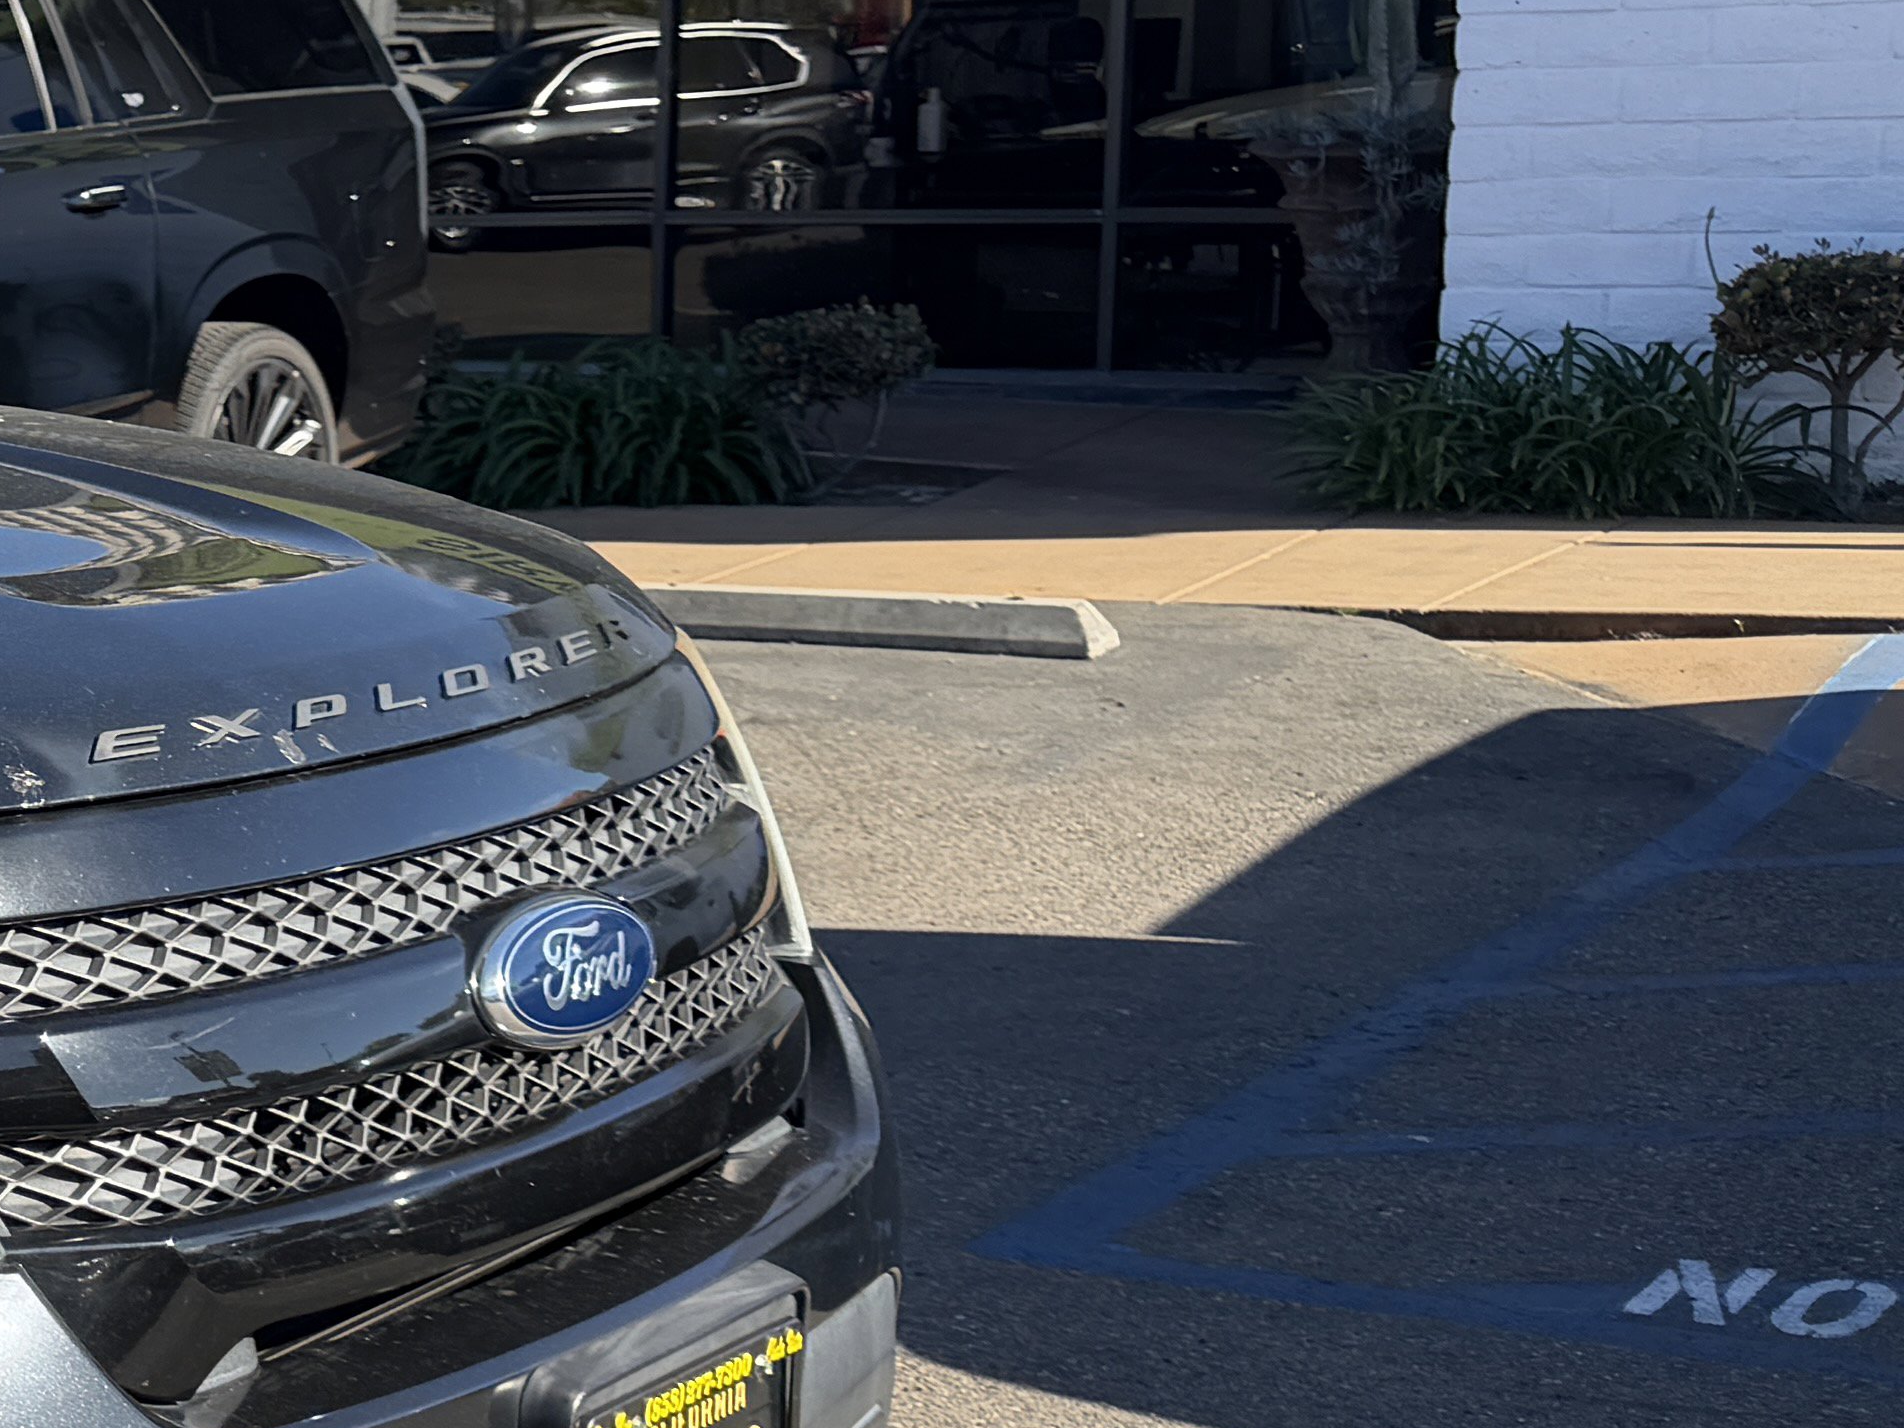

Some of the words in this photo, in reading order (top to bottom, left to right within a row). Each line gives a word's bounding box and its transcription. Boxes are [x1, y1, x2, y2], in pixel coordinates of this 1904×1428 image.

[89, 619, 630, 765] EXPLORER
[542, 919, 633, 1012] Ford
[1623, 1258, 1899, 1339] NO
